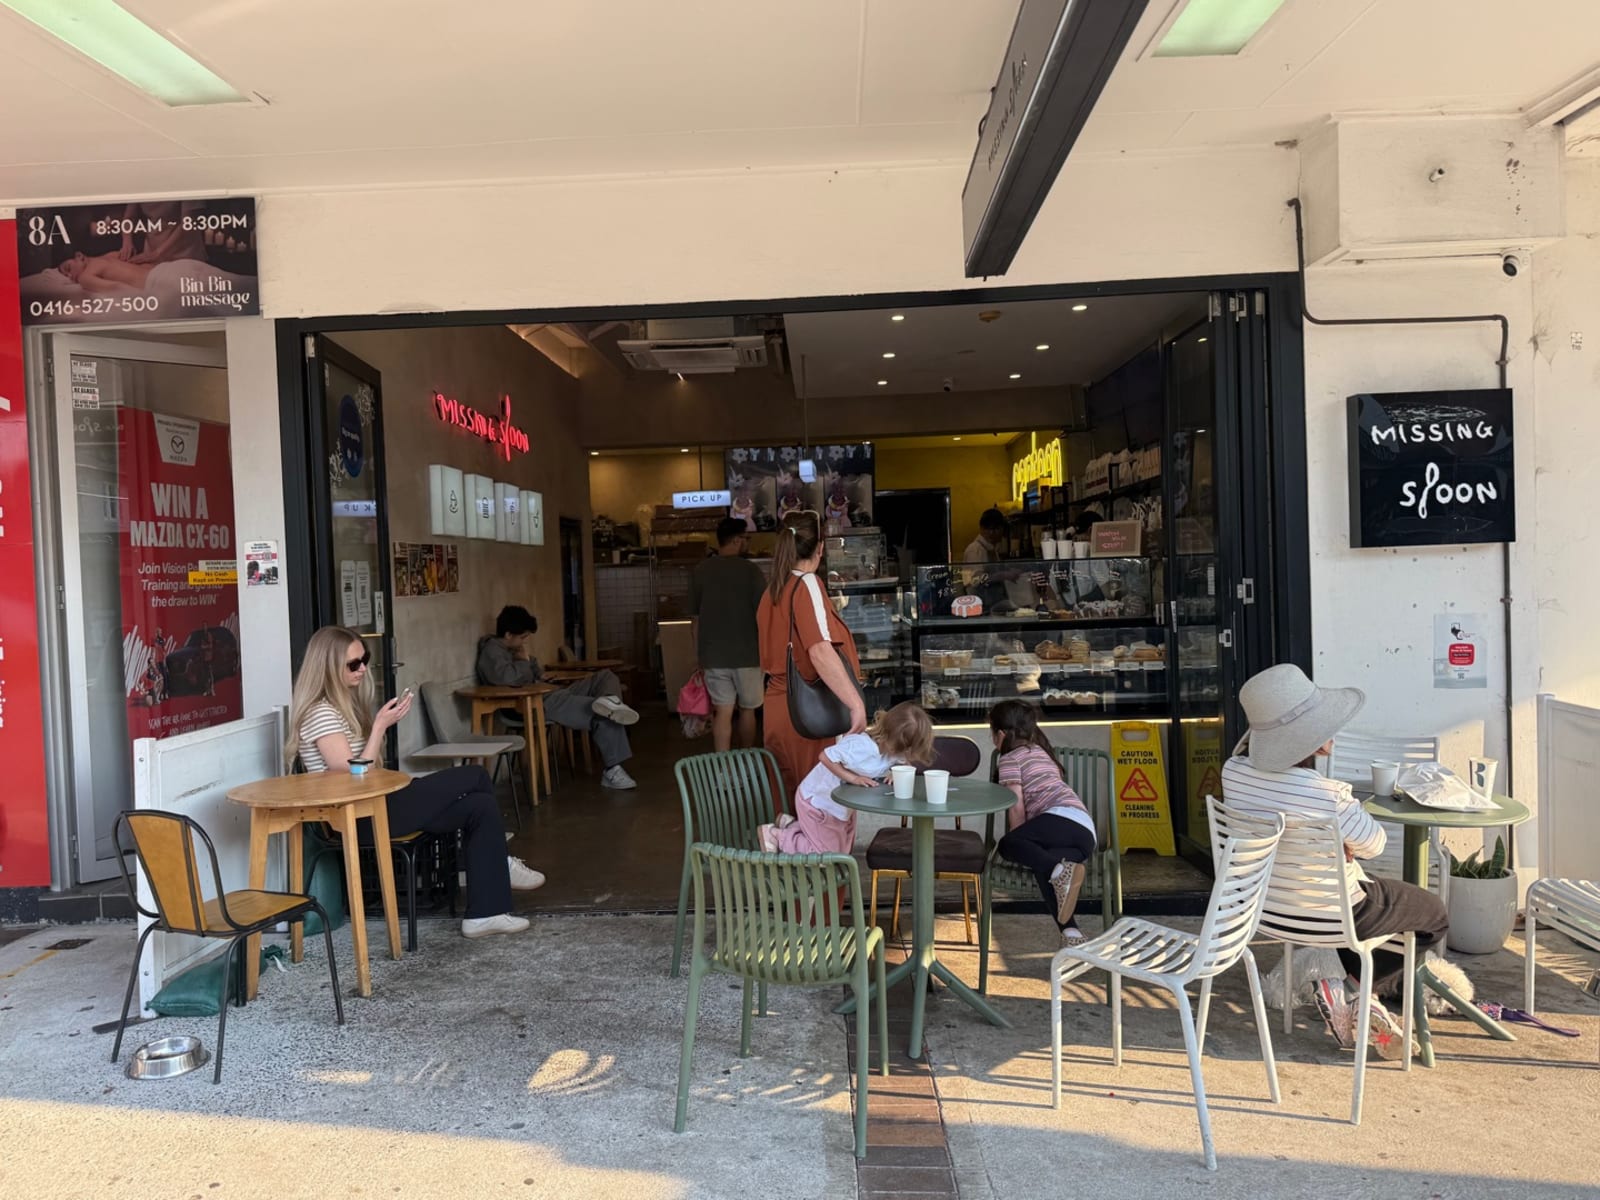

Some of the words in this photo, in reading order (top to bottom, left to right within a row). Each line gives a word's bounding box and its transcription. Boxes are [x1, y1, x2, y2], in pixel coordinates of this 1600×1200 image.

[28, 215, 71, 246] 8A
[96, 218, 162, 235] 8:30AM
[182, 214, 247, 231] 8:30PM
[180, 277, 204, 293] Bin
[208, 276, 232, 292] Bin
[30, 296, 159, 317] 0416-527-500
[181, 292, 250, 311] massage
[436, 394, 496, 442] MISSING
[1371, 421, 1493, 445] MISSING
[681, 495, 705, 503] PICK
[710, 494, 722, 502] UP
[1399, 462, 1497, 519] SPOON
[151, 483, 191, 519] WIN
[195, 487, 208, 520] A
[130, 520, 184, 548] MAZDA
[186, 524, 230, 549] CX-60
[138, 562, 161, 574] Join
[162, 562, 186, 574] Vision
[142, 578, 180, 592] Training
[151, 595, 167, 607] the
[168, 594, 189, 605] draw
[190, 595, 198, 605] to
[1128, 811, 1160, 819] PROGRESS
